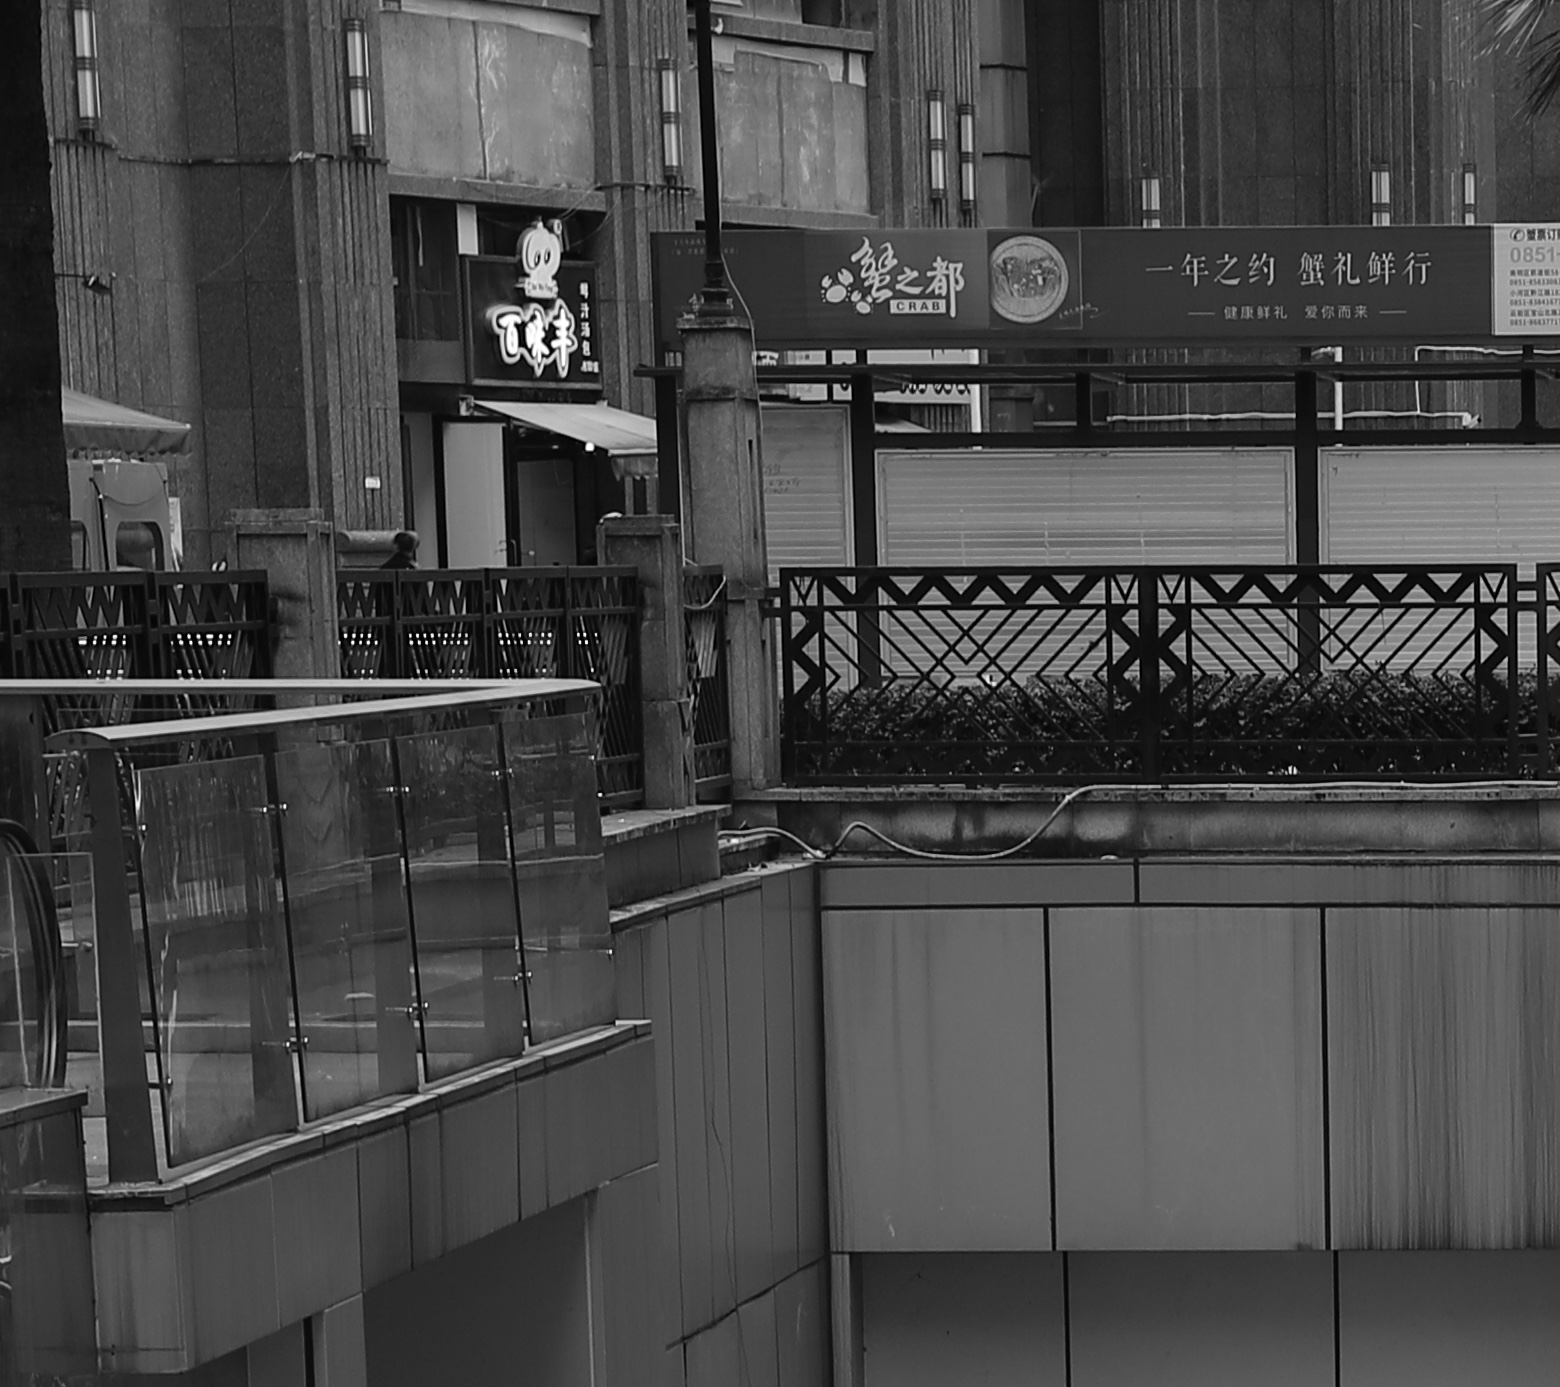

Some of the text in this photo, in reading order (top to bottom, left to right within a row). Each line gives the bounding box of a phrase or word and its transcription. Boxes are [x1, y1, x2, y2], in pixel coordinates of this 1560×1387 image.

[851, 236, 965, 318] 蟹之都
[1145, 251, 1432, 287] 一年之约 蟹礼鲜行
[896, 301, 941, 312] CRAB
[1224, 305, 1368, 320] 健康鲜礼 爱你而来
[495, 306, 575, 370] 百味丰
